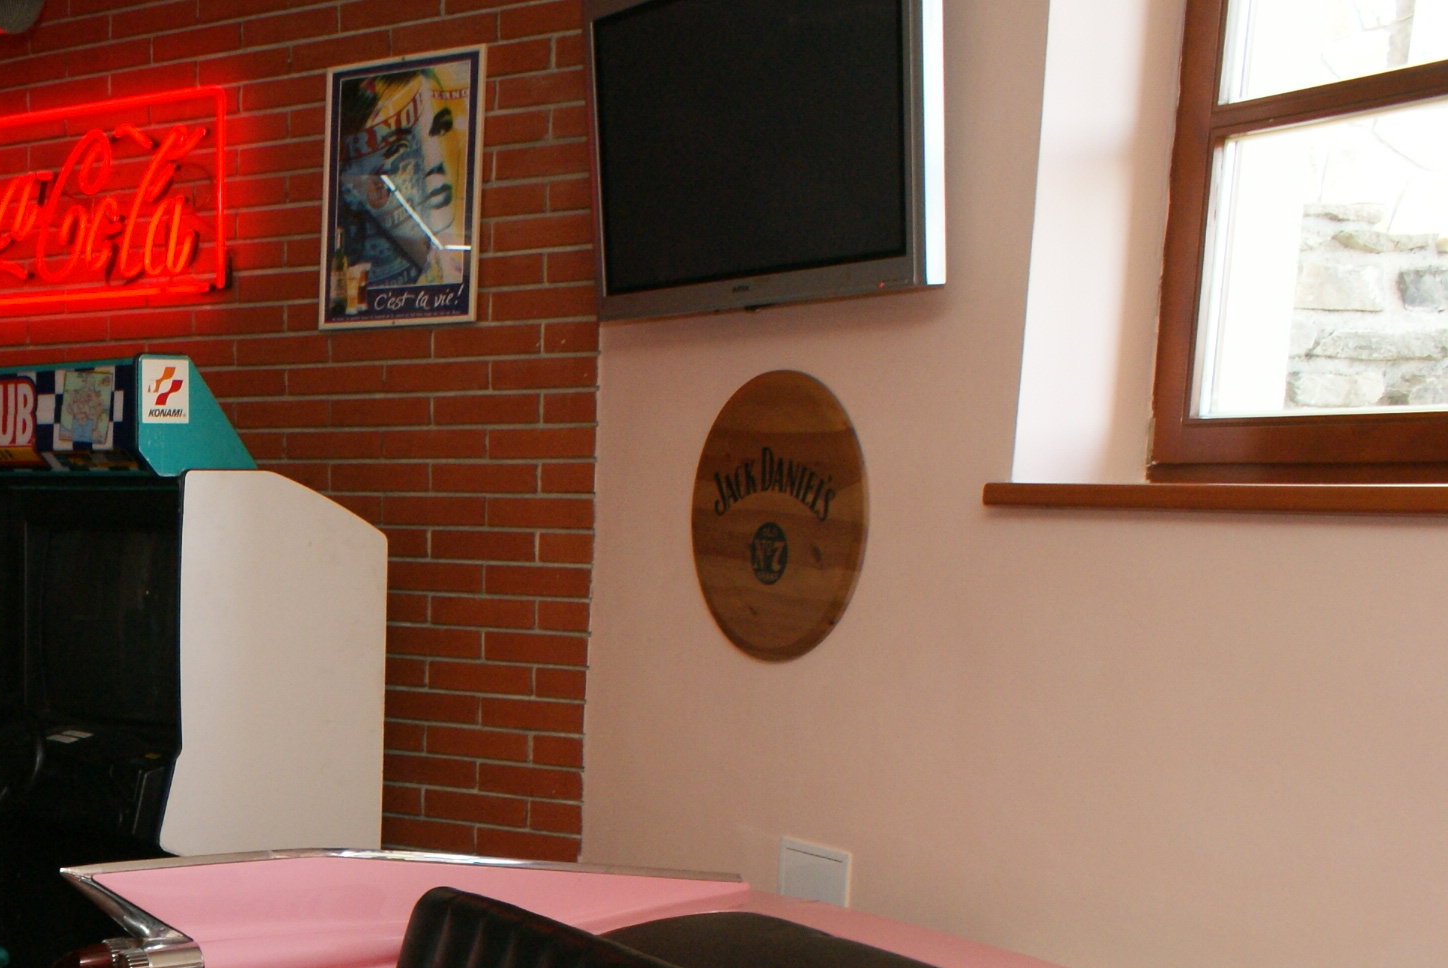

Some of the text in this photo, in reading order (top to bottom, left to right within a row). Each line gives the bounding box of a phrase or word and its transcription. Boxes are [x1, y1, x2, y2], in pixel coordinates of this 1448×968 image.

[373, 282, 464, 310] C'est la vie!
[148, 408, 183, 418] KONAMI
[713, 447, 836, 522] JACK DANIEL'S
